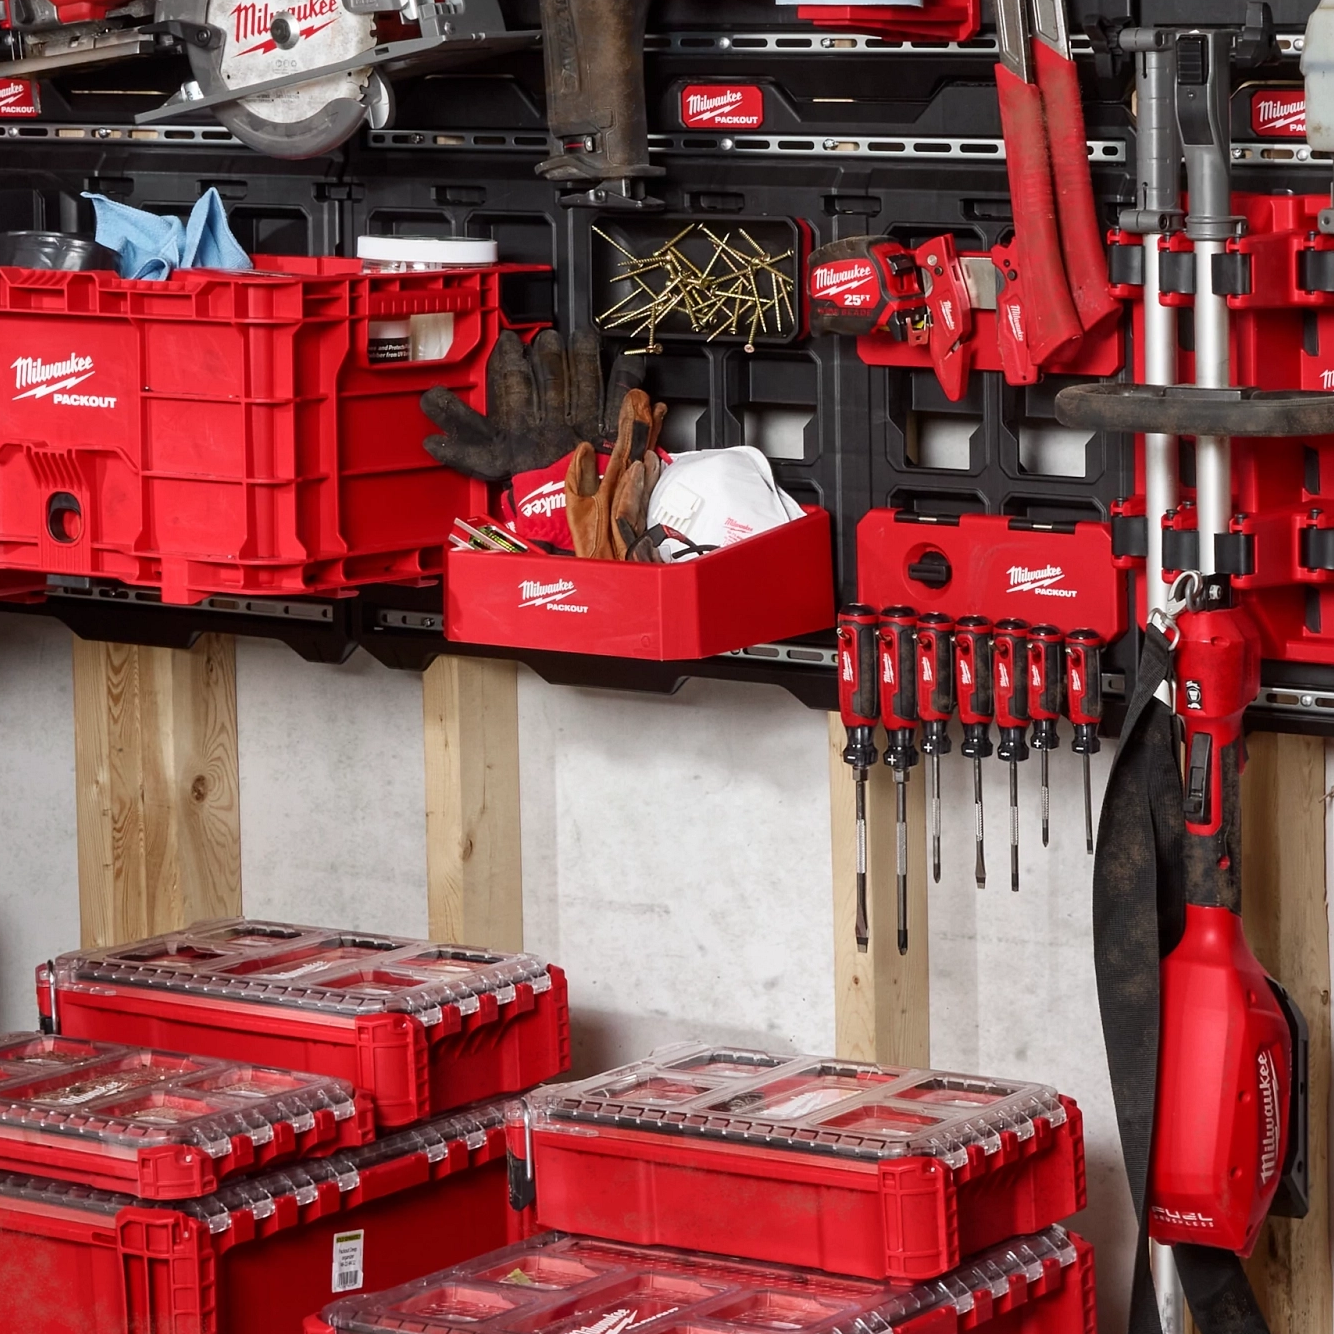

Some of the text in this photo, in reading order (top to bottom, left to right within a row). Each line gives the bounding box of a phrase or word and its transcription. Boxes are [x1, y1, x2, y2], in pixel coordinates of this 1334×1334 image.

[0, 106, 36, 114] PACKOUT
[686, 90, 743, 115] Milwaukee
[1256, 100, 1306, 123] Milwau
[714, 116, 759, 124] PACKOUT
[813, 264, 873, 290] Milwaukee
[1009, 303, 1024, 342] Milwaukee
[10, 352, 94, 389] Milwaukee
[53, 393, 117, 409] PACKOUT
[1005, 564, 1064, 587] Milwaukee
[518, 578, 575, 601] Milwaukee
[1034, 587, 1078, 598] PACKOUT
[546, 602, 589, 614] PACKOUT
[1257, 1051, 1276, 1185] Milwaukee
[1152, 1205, 1213, 1222] FUEL
